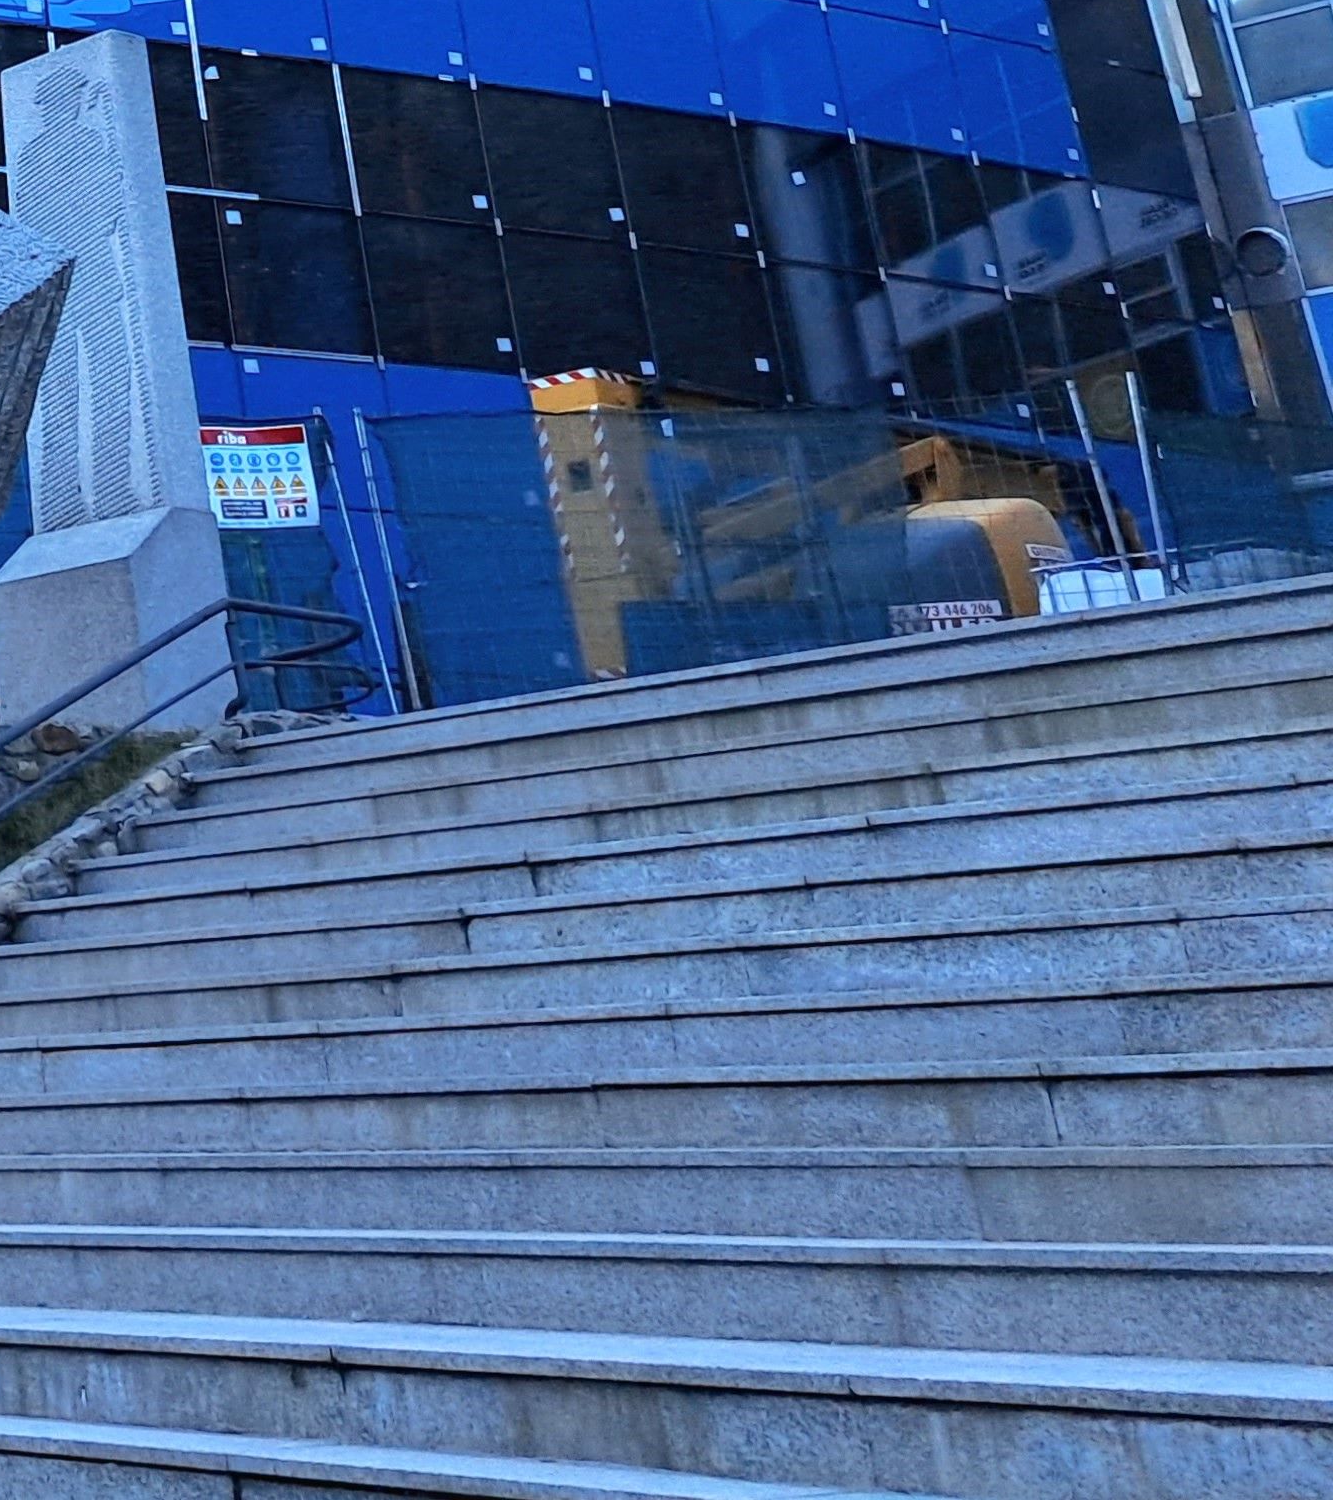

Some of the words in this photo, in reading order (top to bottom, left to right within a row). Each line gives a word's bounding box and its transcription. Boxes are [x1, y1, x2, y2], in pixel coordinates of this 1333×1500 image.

[216, 430, 248, 445] riba
[944, 603, 968, 616] 446
[970, 602, 994, 615] 206
